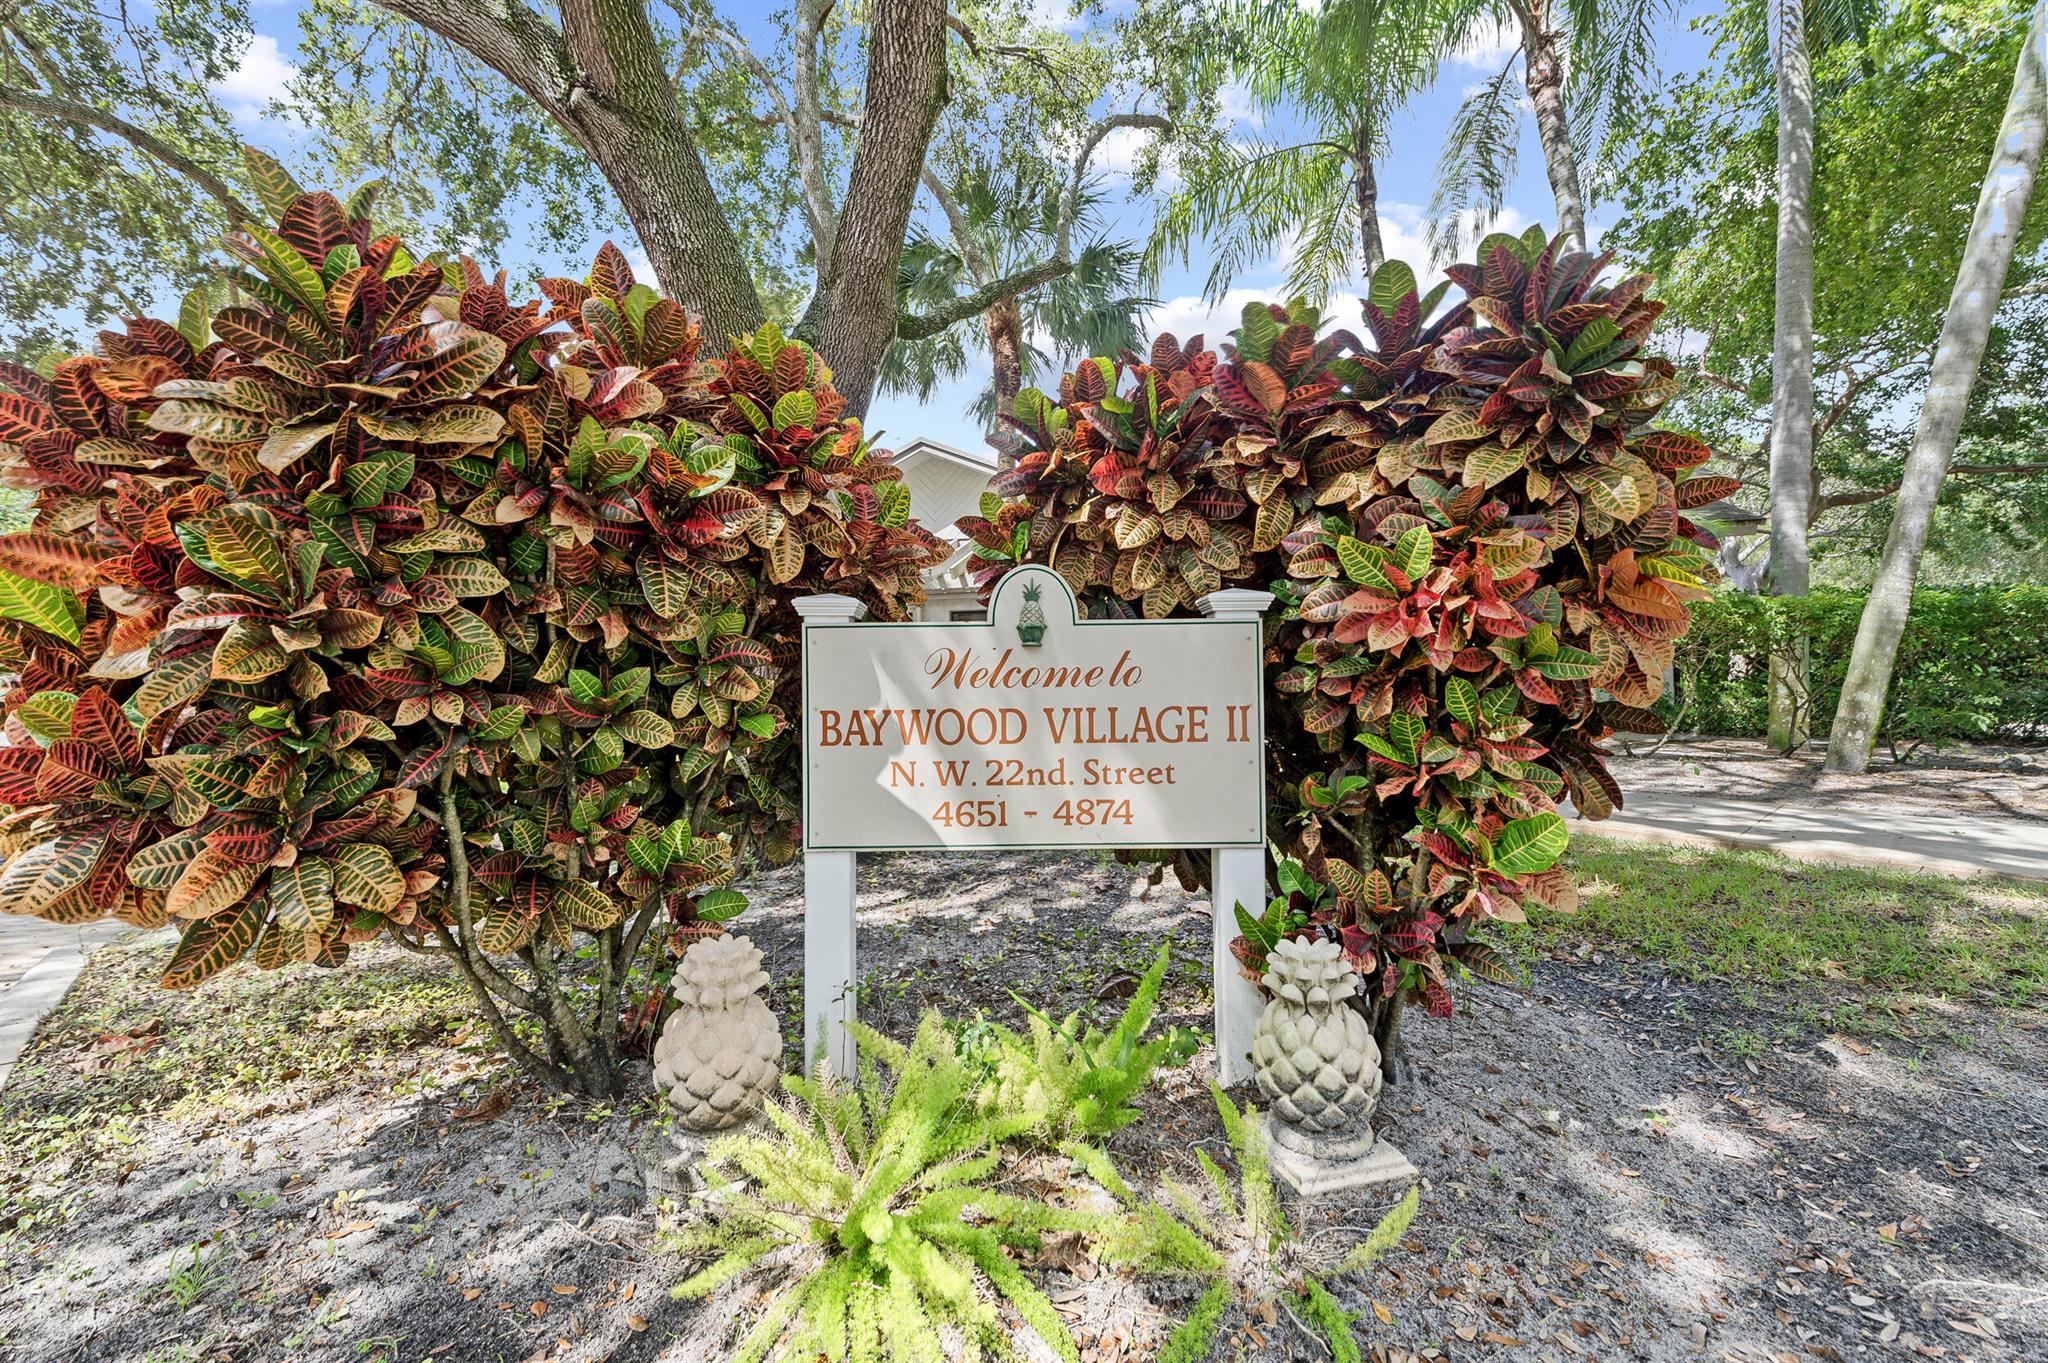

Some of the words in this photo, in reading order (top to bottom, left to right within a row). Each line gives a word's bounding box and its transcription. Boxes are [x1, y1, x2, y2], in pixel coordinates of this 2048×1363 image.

[924, 647, 1102, 690] Welcome
[1110, 650, 1142, 687] to
[819, 707, 1029, 747] BAYWOOD
[1044, 705, 1209, 745] VILLAGE
[1227, 705, 1250, 743] II
[985, 758, 1074, 787] 22nd.
[1083, 758, 1176, 786] Street
[932, 800, 1008, 828] 4651
[1053, 799, 1134, 827] 4874
